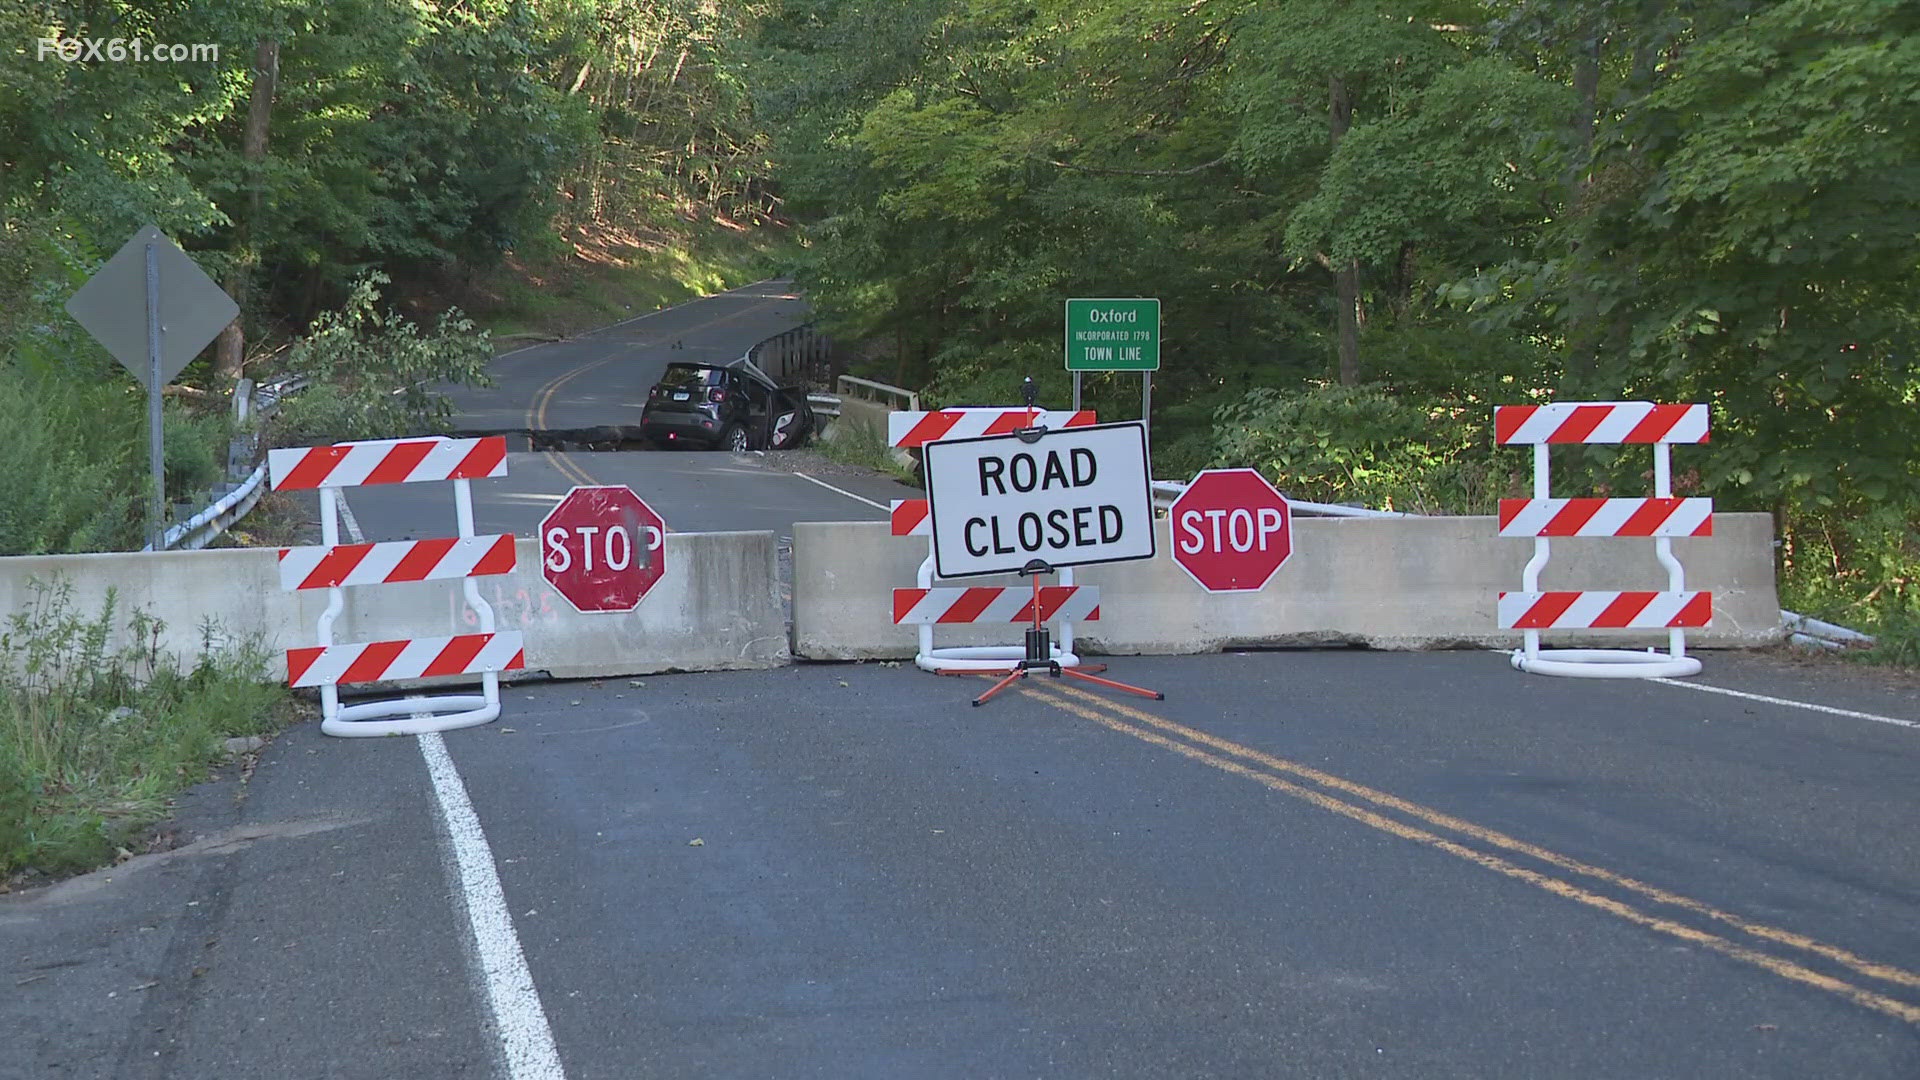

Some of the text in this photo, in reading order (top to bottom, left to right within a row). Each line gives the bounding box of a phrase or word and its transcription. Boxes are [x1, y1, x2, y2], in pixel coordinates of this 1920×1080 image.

[1075, 331, 1150, 341] INCORPORATED 1798
[1090, 309, 1136, 323] Oxford
[1085, 347, 1142, 361] TOWN LINE
[978, 448, 1097, 496] ROAD
[546, 526, 662, 573] STOP
[964, 504, 1123, 557] CLOSED
[1180, 508, 1282, 554] STOP
